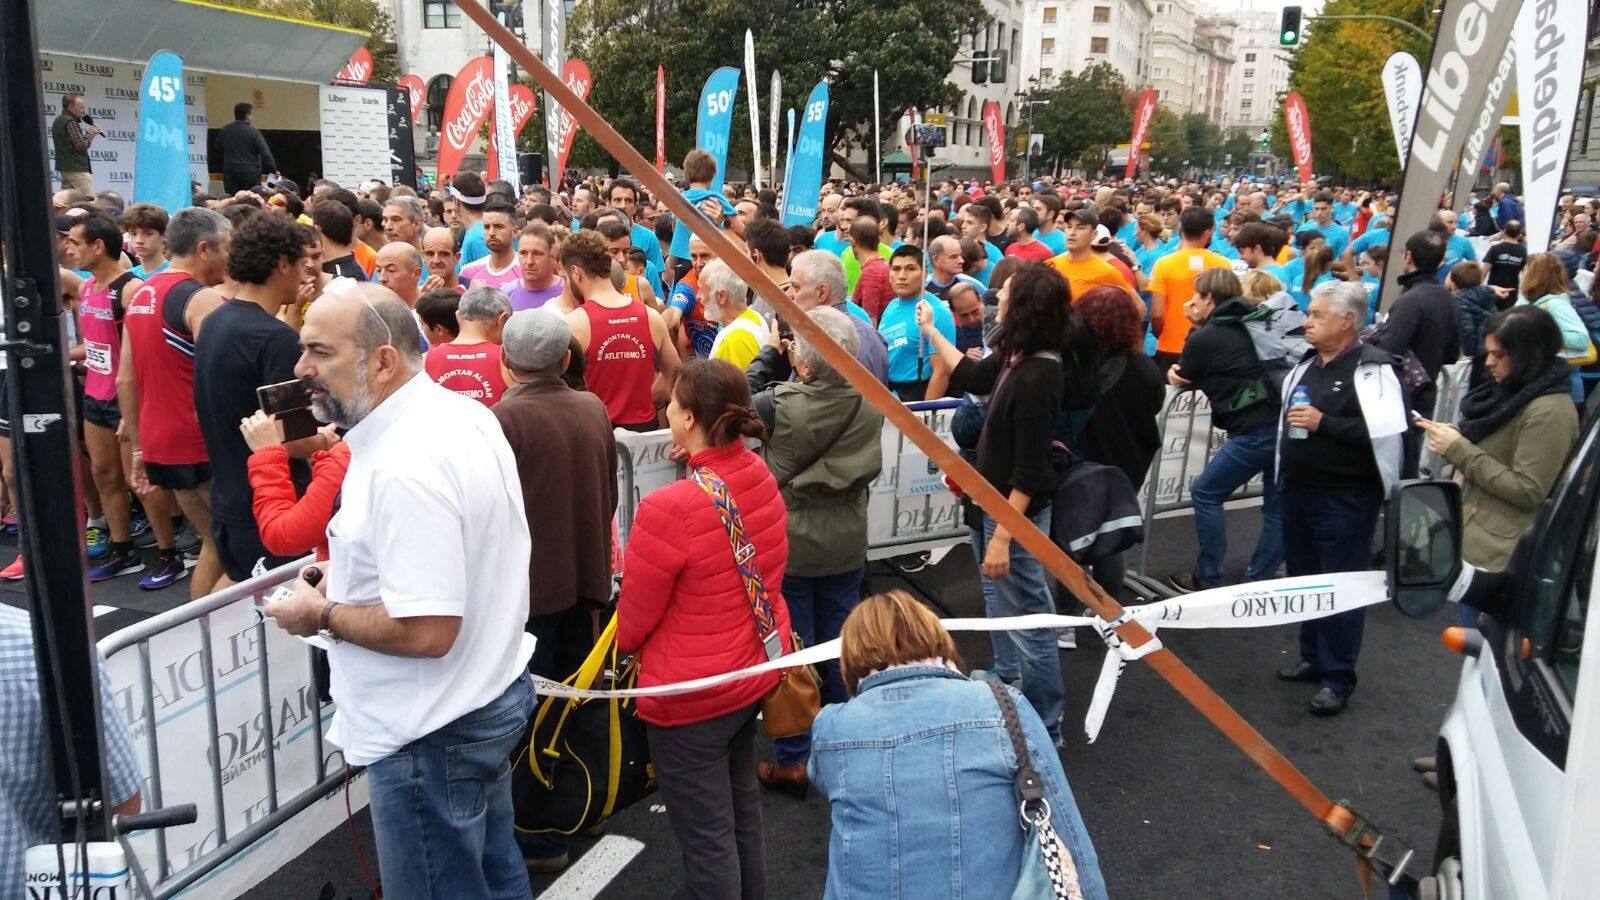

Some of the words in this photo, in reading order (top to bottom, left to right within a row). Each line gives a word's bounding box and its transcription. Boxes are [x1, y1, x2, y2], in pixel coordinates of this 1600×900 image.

[85, 63, 114, 74] DIARIO
[57, 82, 85, 93] DIARIO
[148, 75, 181, 103] 45'
[1411, 0, 1497, 172] Libe
[328, 94, 347, 104] Liber
[362, 96, 379, 106] bank
[706, 89, 732, 117] 50'
[807, 100, 825, 123] 55'
[1462, 29, 1518, 176] Liberban
[144, 117, 184, 151] DM
[704, 130, 728, 154] DM
[801, 135, 822, 158] DM
[604, 351, 640, 361] ATLETISMO
[437, 369, 473, 383] MONTAN
[472, 372, 483, 382] AL
[482, 380, 493, 398] MAR
[1231, 594, 1305, 618] DIARIO
[1309, 592, 1335, 611] EL
